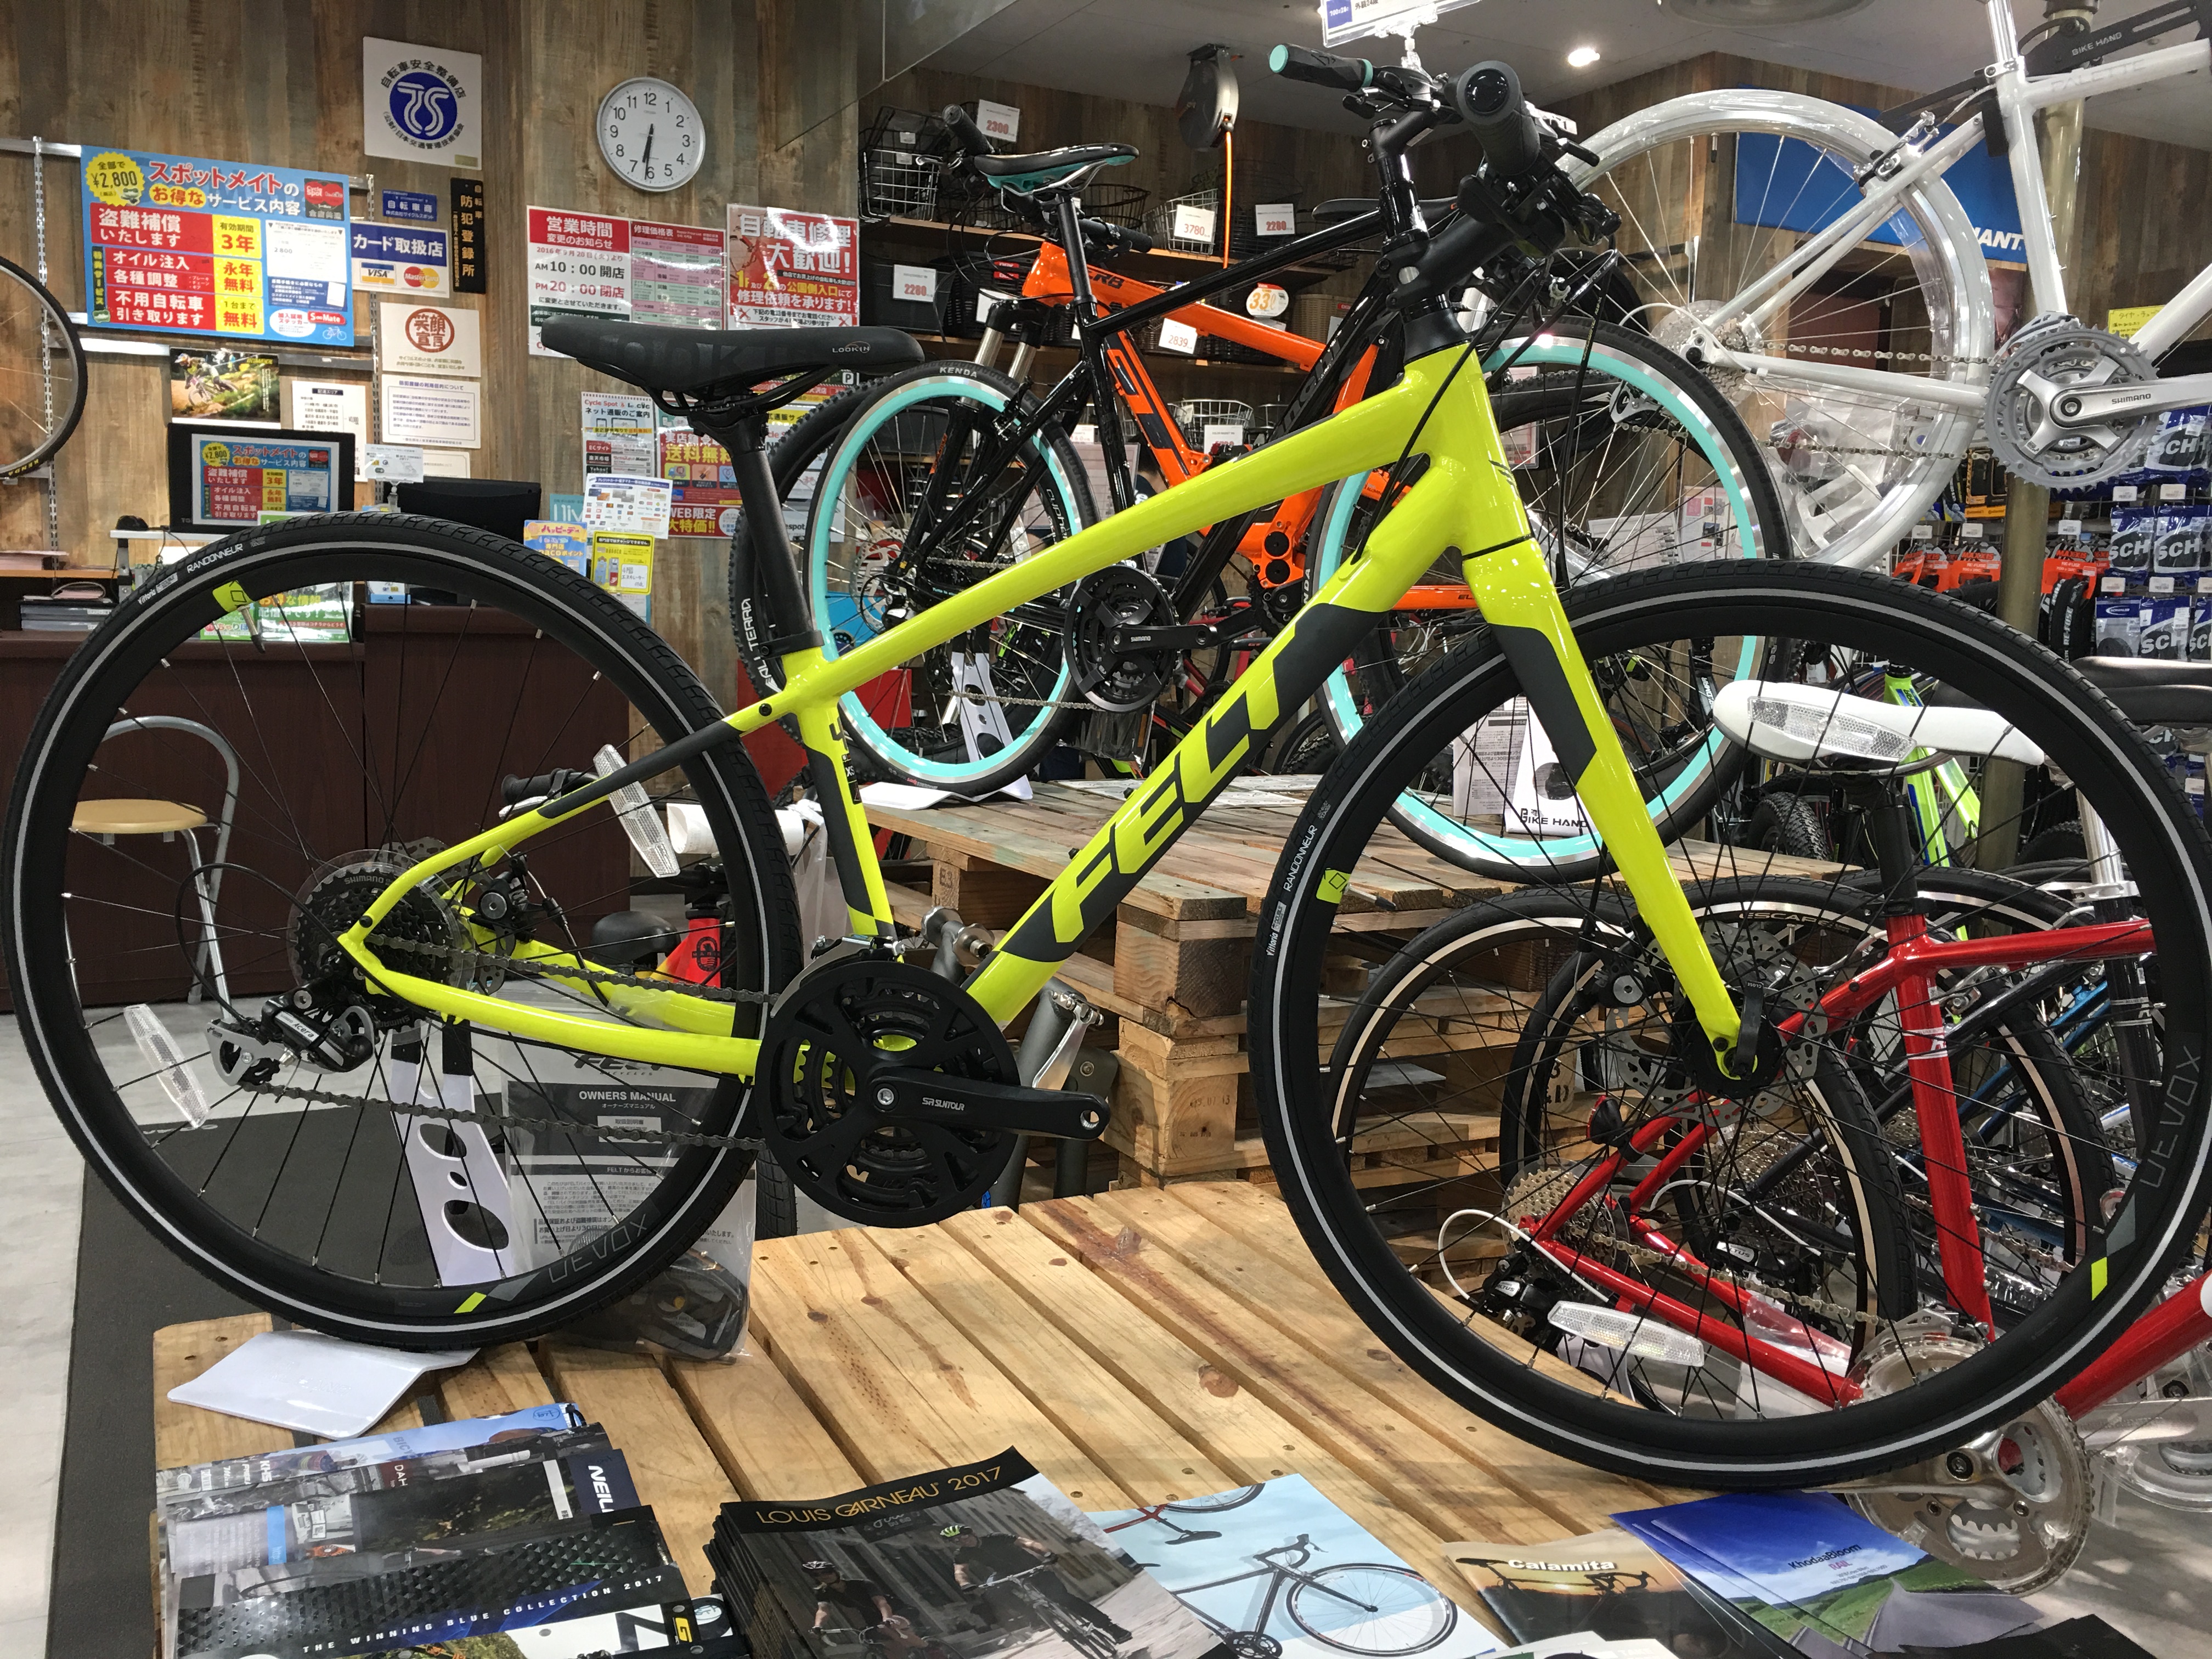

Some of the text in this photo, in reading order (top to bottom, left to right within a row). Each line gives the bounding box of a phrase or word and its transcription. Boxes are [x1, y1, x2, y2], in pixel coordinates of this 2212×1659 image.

[2072, 32, 2123, 57] BIKE HAND
[380, 59, 466, 98] 自転車安全整備店
[627, 95, 637, 109] 11
[644, 92, 656, 105] 12
[613, 106, 626, 120] 10
[665, 101, 669, 113] 1
[676, 115, 684, 128] 2
[987, 120, 1008, 134] 2300
[610, 125, 618, 138] 9
[682, 134, 690, 147] 3
[616, 144, 624, 157] 8
[98, 161, 126, 170] 全部で
[629, 160, 637, 172] 7
[676, 153, 684, 165] 4
[647, 166, 654, 179] 6
[664, 163, 672, 177] 5
[91, 170, 138, 189] ¥2,800
[149, 161, 300, 196] スポットメイトの
[153, 186, 204, 205] お得な
[207, 193, 301, 216] サービス内容
[387, 200, 432, 213] 自転車商
[98, 207, 181, 233] 盗難補償
[546, 216, 613, 238] 営業時間
[1266, 221, 1287, 230] 2280
[219, 222, 254, 233] 有効期間
[634, 224, 674, 237] 修理価格表
[1184, 224, 1205, 236] 3780
[100, 228, 180, 247] いたします
[460, 195, 475, 277] 防犯登録所
[547, 233, 613, 249] 変更のお知らせ
[1974, 227, 2024, 250] IANT
[221, 234, 255, 253] 3年
[353, 234, 443, 257] カード取扱店
[113, 251, 190, 270] オイル注入
[223, 262, 253, 277] 永年
[368, 269, 388, 278] VISA
[600, 265, 624, 279] 開店
[114, 269, 178, 288] 各種調整
[224, 277, 253, 292] 無料
[405, 273, 439, 282] MasterCard
[600, 285, 624, 298] 閉店
[905, 284, 927, 296] 2280
[115, 290, 204, 311] 不用自転車
[224, 301, 256, 311] 1台まで
[539, 297, 622, 311] に変更とさせていただきます。
[116, 307, 204, 326] 引き取ります
[223, 311, 257, 328] 無料
[414, 314, 445, 333] 笑顔
[416, 332, 445, 347] 宣言
[1168, 335, 1188, 347] 2839
[939, 366, 978, 379] KENDA
[2112, 393, 2151, 404] SHIMANO
[585, 407, 650, 418] ネット通販のご案内
[233, 445, 306, 458] スポットメイトの
[261, 458, 307, 467] サービス内容
[267, 477, 283, 485] 3年
[670, 508, 716, 520] WEB限定
[541, 525, 580, 534] ハッピーデー
[187, 543, 243, 573] RANDONNEUR
[1962, 551, 1994, 560] MAXXIS
[2056, 550, 2087, 558] MAXXIS
[845, 766, 855, 776] XS
[1052, 620, 1297, 943] FELT
[1520, 808, 1548, 825] BIKE
[1266, 932, 1278, 956] Vittoria
[1284, 825, 1318, 891] RANDONNEUR
[579, 1091, 676, 1103] OWNERS MANUAL
[935, 1099, 964, 1111] SUNTOUR
[260, 1460, 272, 1482] KHS
[756, 1466, 1001, 1524] LOUIS GARNEAU 2017
[1787, 1543, 1862, 1570] KhodaaBloom
[1508, 1558, 1616, 1572] Calamita
[1828, 1560, 1853, 1571] RAIL
[303, 1575, 663, 1654] THE WINNING BLUE COLLECTION 2017
